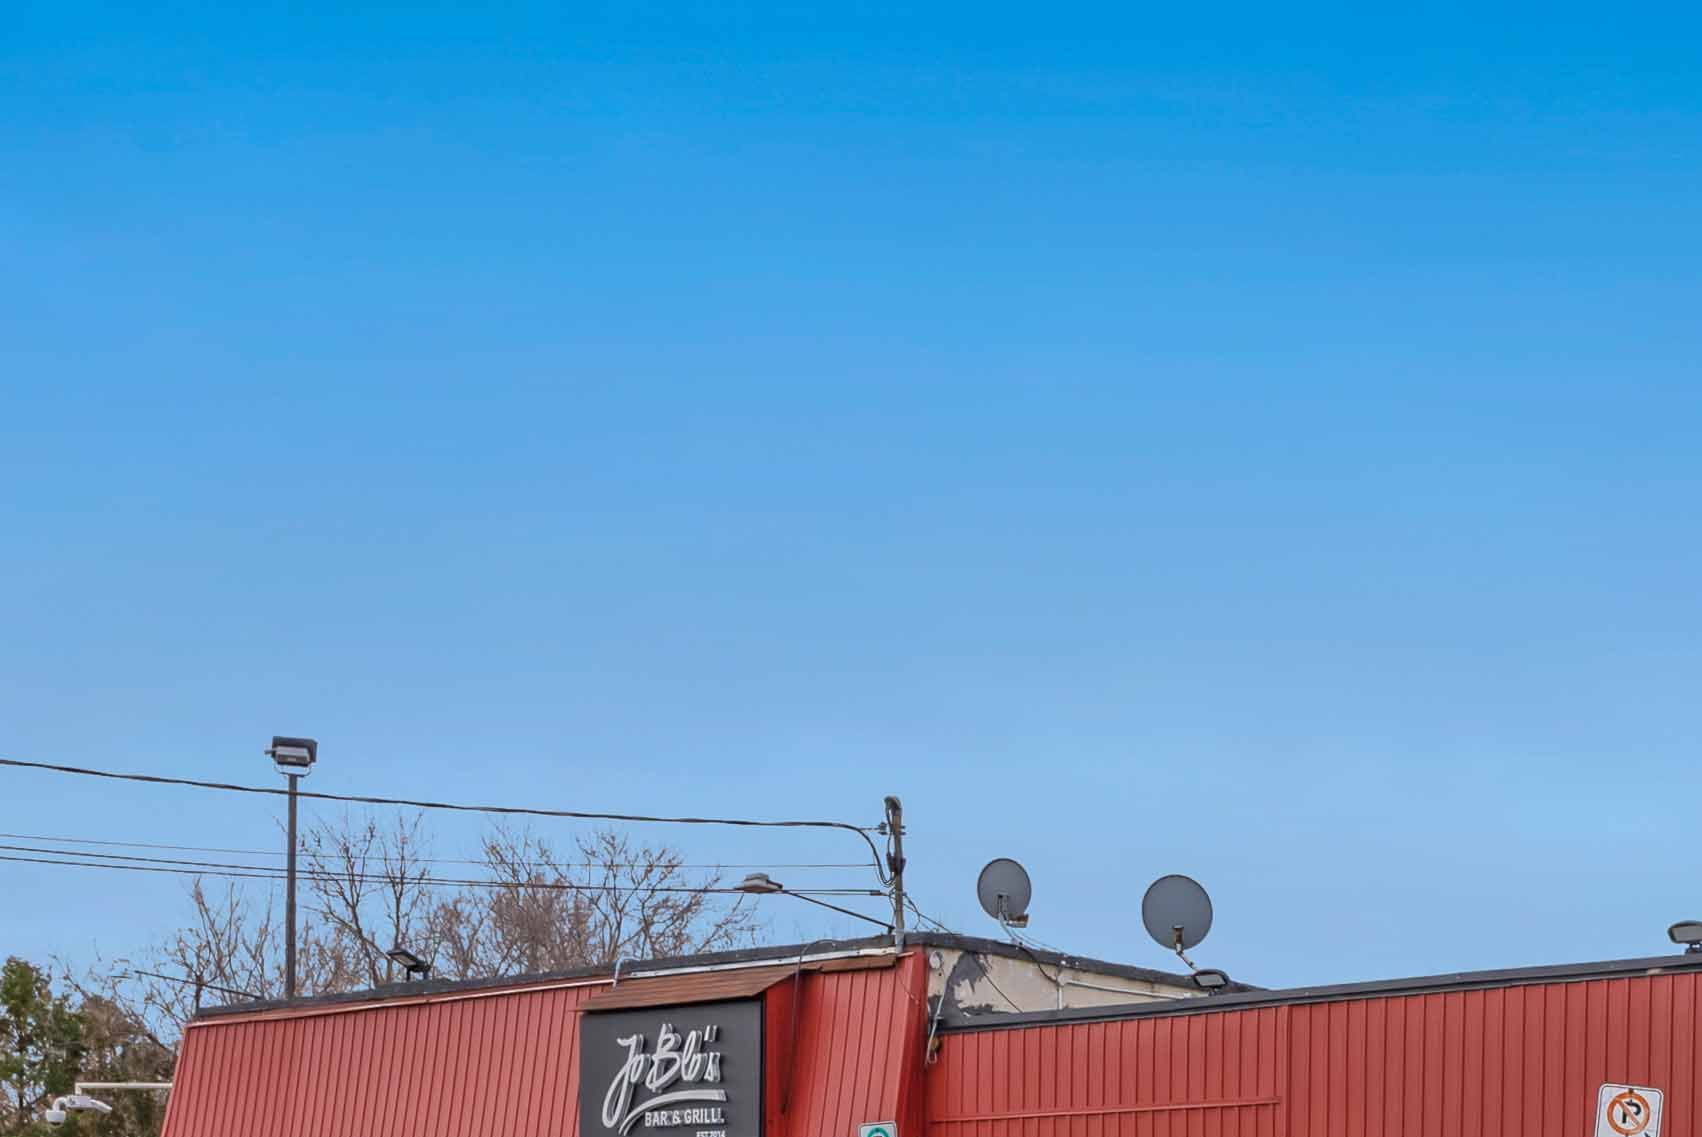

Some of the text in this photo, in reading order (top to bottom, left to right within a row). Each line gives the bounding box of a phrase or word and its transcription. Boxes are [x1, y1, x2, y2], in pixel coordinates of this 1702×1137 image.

[645, 1107, 725, 1127] BAR & GRILL
